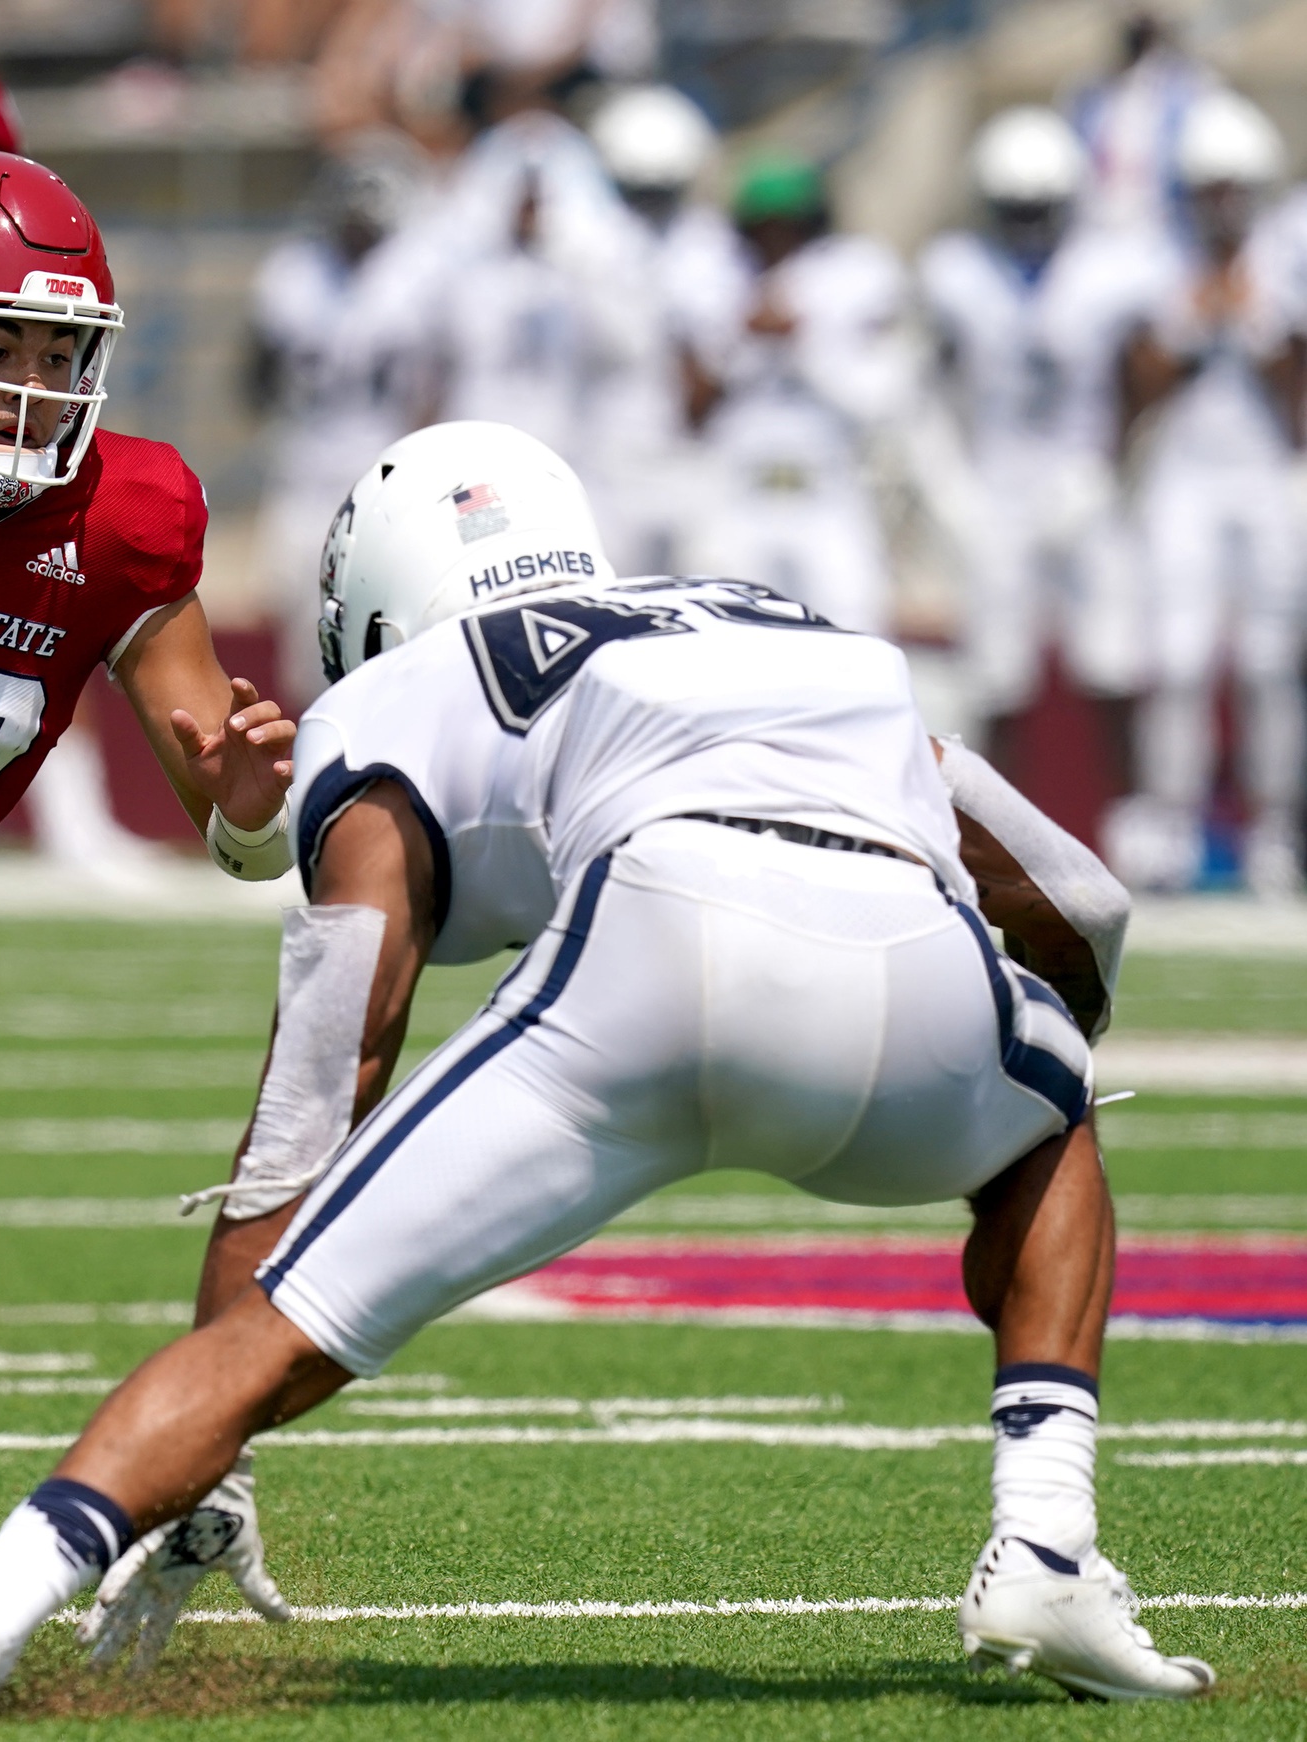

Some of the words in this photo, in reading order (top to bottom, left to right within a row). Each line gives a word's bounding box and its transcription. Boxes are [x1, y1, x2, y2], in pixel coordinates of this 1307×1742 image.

[46, 278, 84, 297] 'DOGS
[60, 376, 93, 424] Ridell
[26, 560, 86, 585] adidas
[470, 551, 595, 598] HUSKIES
